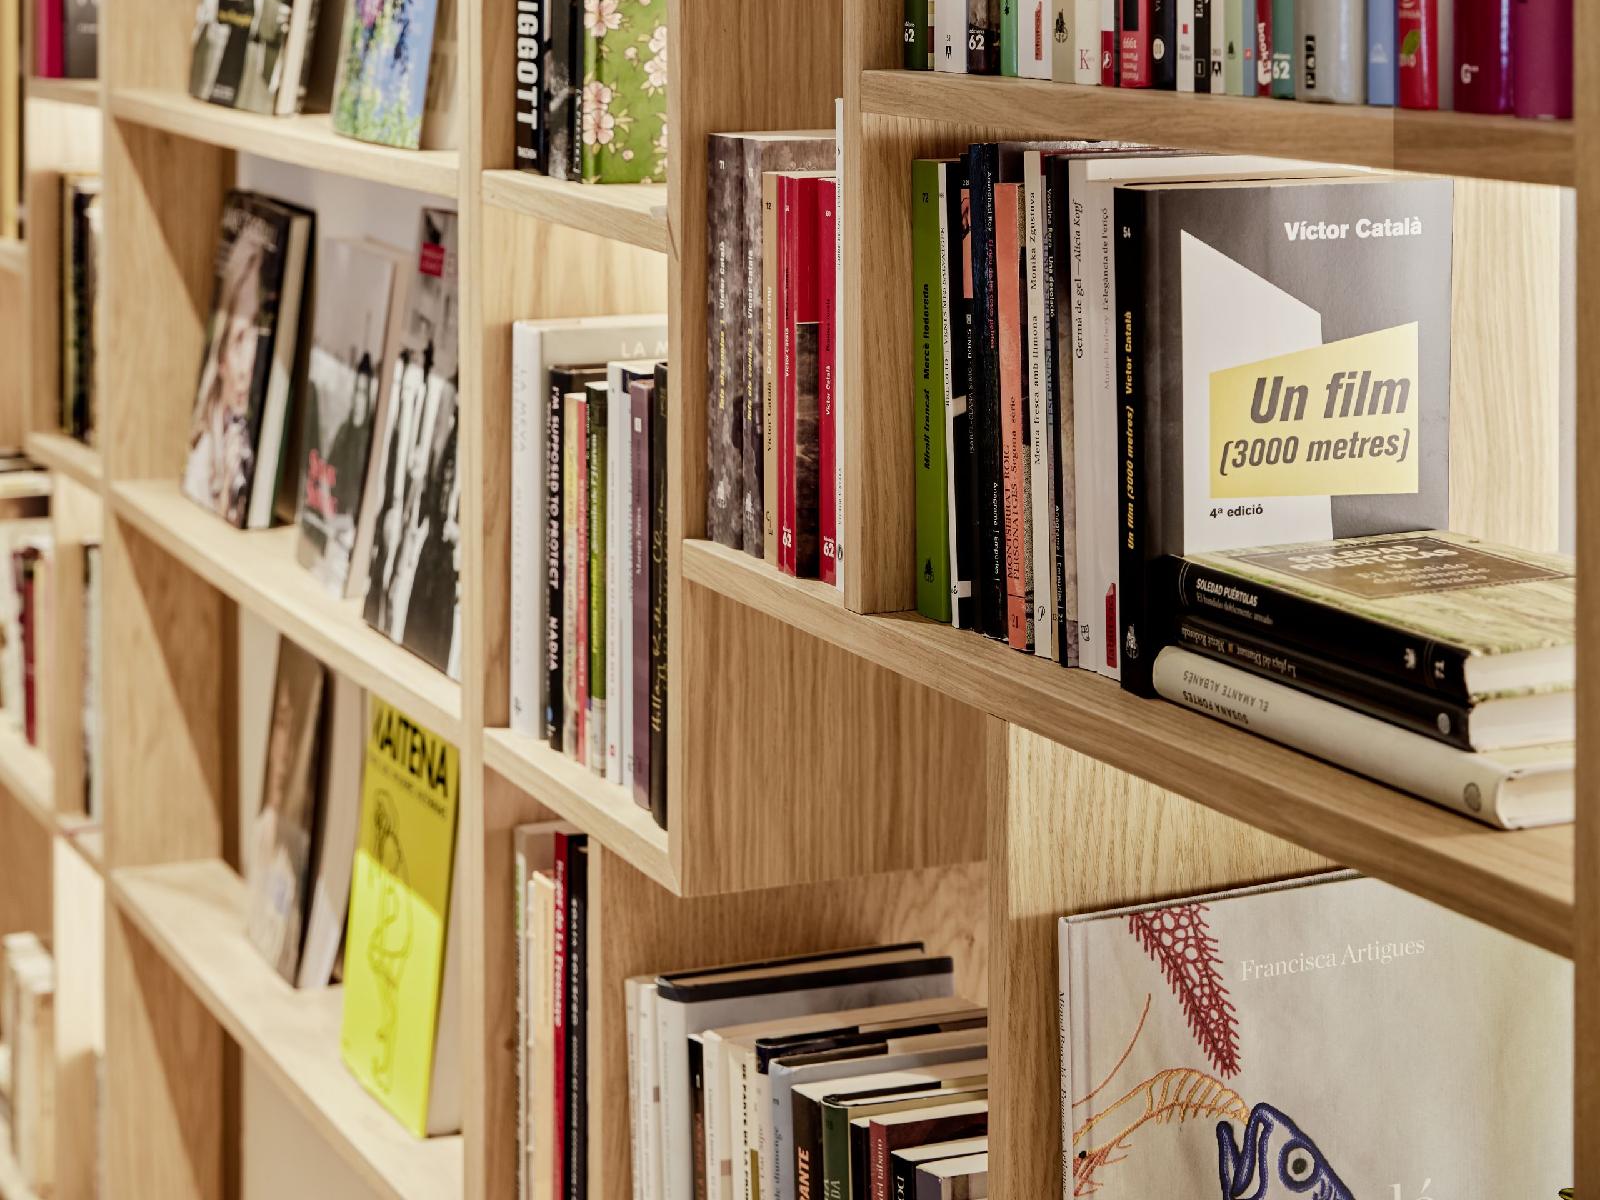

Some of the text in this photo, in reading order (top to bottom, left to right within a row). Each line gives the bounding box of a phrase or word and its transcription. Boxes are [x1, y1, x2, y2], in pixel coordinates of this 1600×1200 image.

[969, 36, 985, 51] 62
[1273, 60, 1291, 80] 62
[1072, 199, 1082, 227] Kopf
[1100, 208, 1110, 239] l'eriçó
[1283, 215, 1422, 242] Víctor Català
[1047, 255, 1055, 268] Una
[1101, 241, 1109, 254] de
[1029, 248, 1037, 291] Monika
[1101, 257, 1110, 312] L'elegància
[1047, 271, 1055, 316] desolació
[922, 284, 930, 380] Mercè Rodoreda
[1073, 279, 1084, 360] Germà de gel
[1123, 311, 1133, 354] Català
[548, 385, 559, 409] I'M
[1031, 315, 1041, 465] Menta fresca amb llimona
[1250, 369, 1410, 424] Un film
[548, 413, 560, 491] SUPPOSED
[1219, 427, 1411, 477] (3000 metres)
[1125, 405, 1135, 550] Un film (3000 metres)
[548, 494, 560, 515] TO
[1002, 445, 1014, 580] MONTSERRAT ROIG
[1227, 503, 1264, 518] edició
[549, 518, 560, 588] PROTECT
[782, 532, 792, 548] 62
[824, 540, 834, 557] 62
[1010, 483, 1020, 582] PERSONATGES
[1195, 578, 1258, 608] SOLEDAD PUÉRTOLAS
[1182, 690, 1249, 725] SUSANA FORTES
[1183, 670, 1270, 712] EL AMANTE ALBANÉS
[1240, 938, 1425, 982] Francisca Artigues
